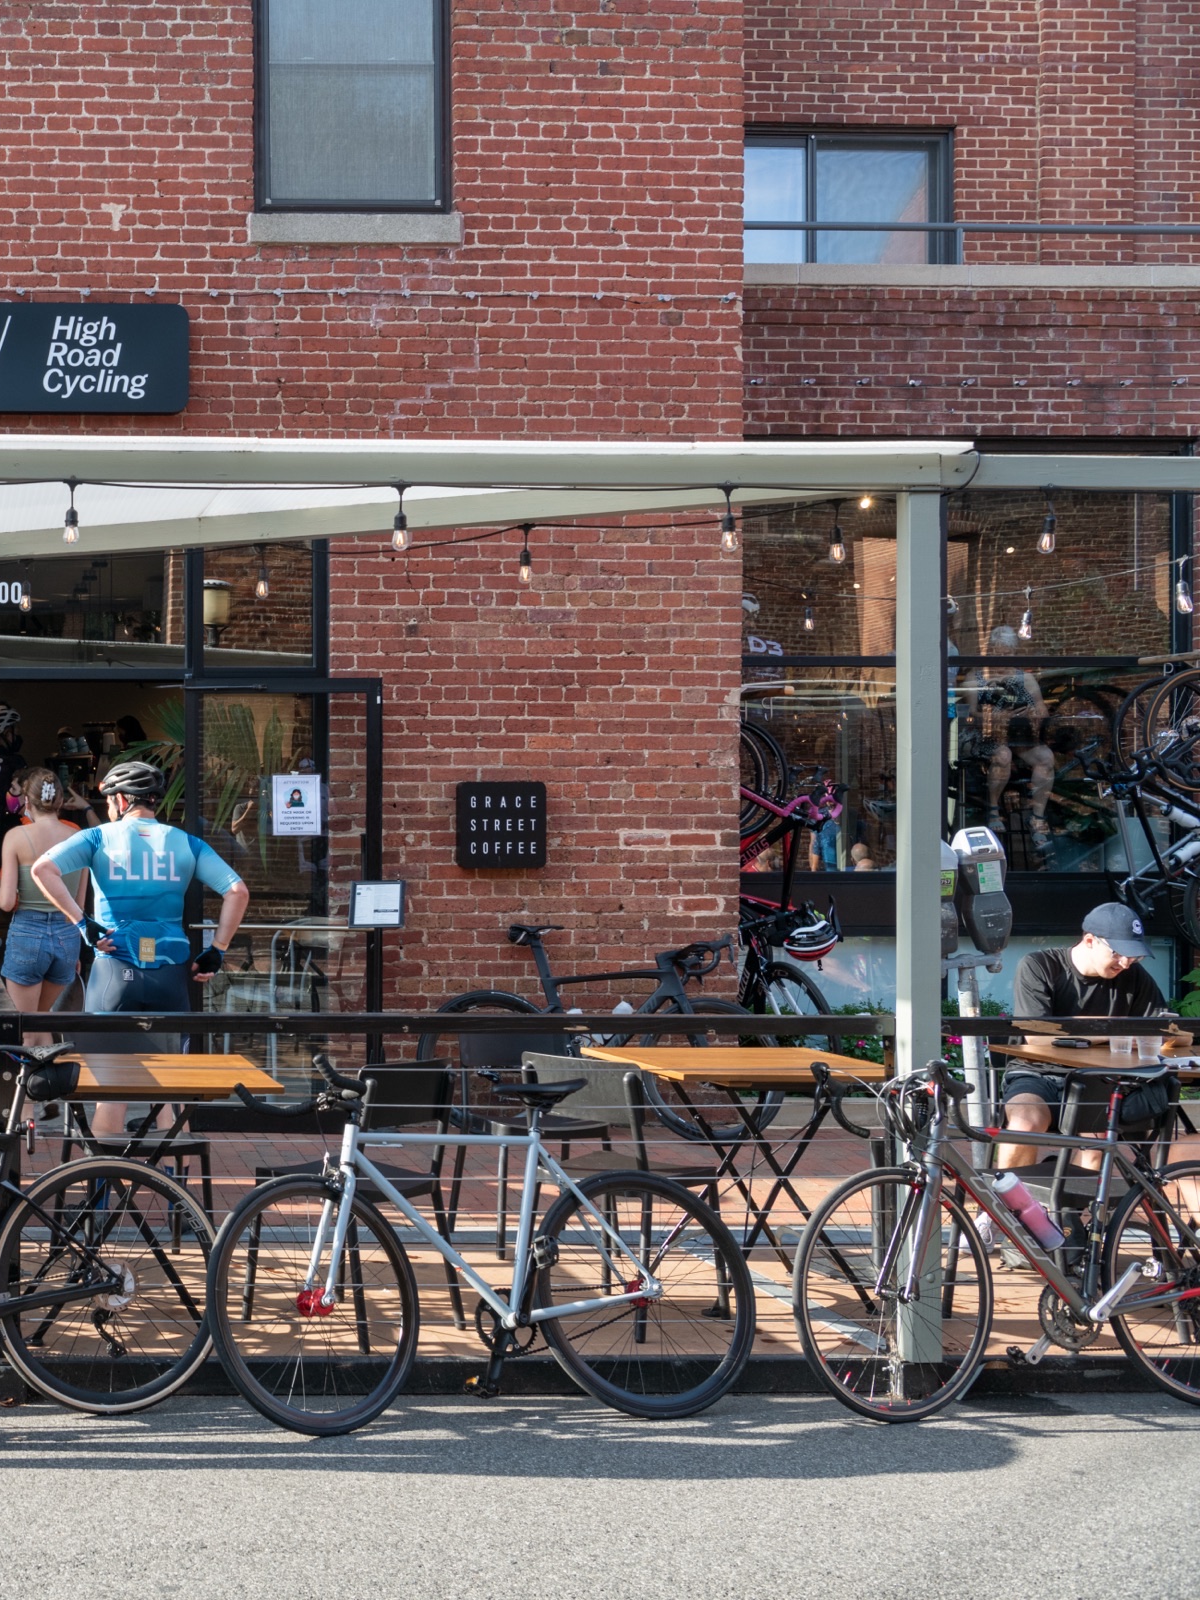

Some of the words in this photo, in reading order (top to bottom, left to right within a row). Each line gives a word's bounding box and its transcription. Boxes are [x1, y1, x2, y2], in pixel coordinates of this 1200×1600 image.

[51, 315, 117, 346] High
[46, 342, 122, 367] Road
[42, 368, 148, 399] Cycling
[470, 795, 537, 809] GRACE
[470, 818, 537, 832] STREET
[470, 841, 537, 855] COFFEE
[108, 850, 181, 882] ELIEL
